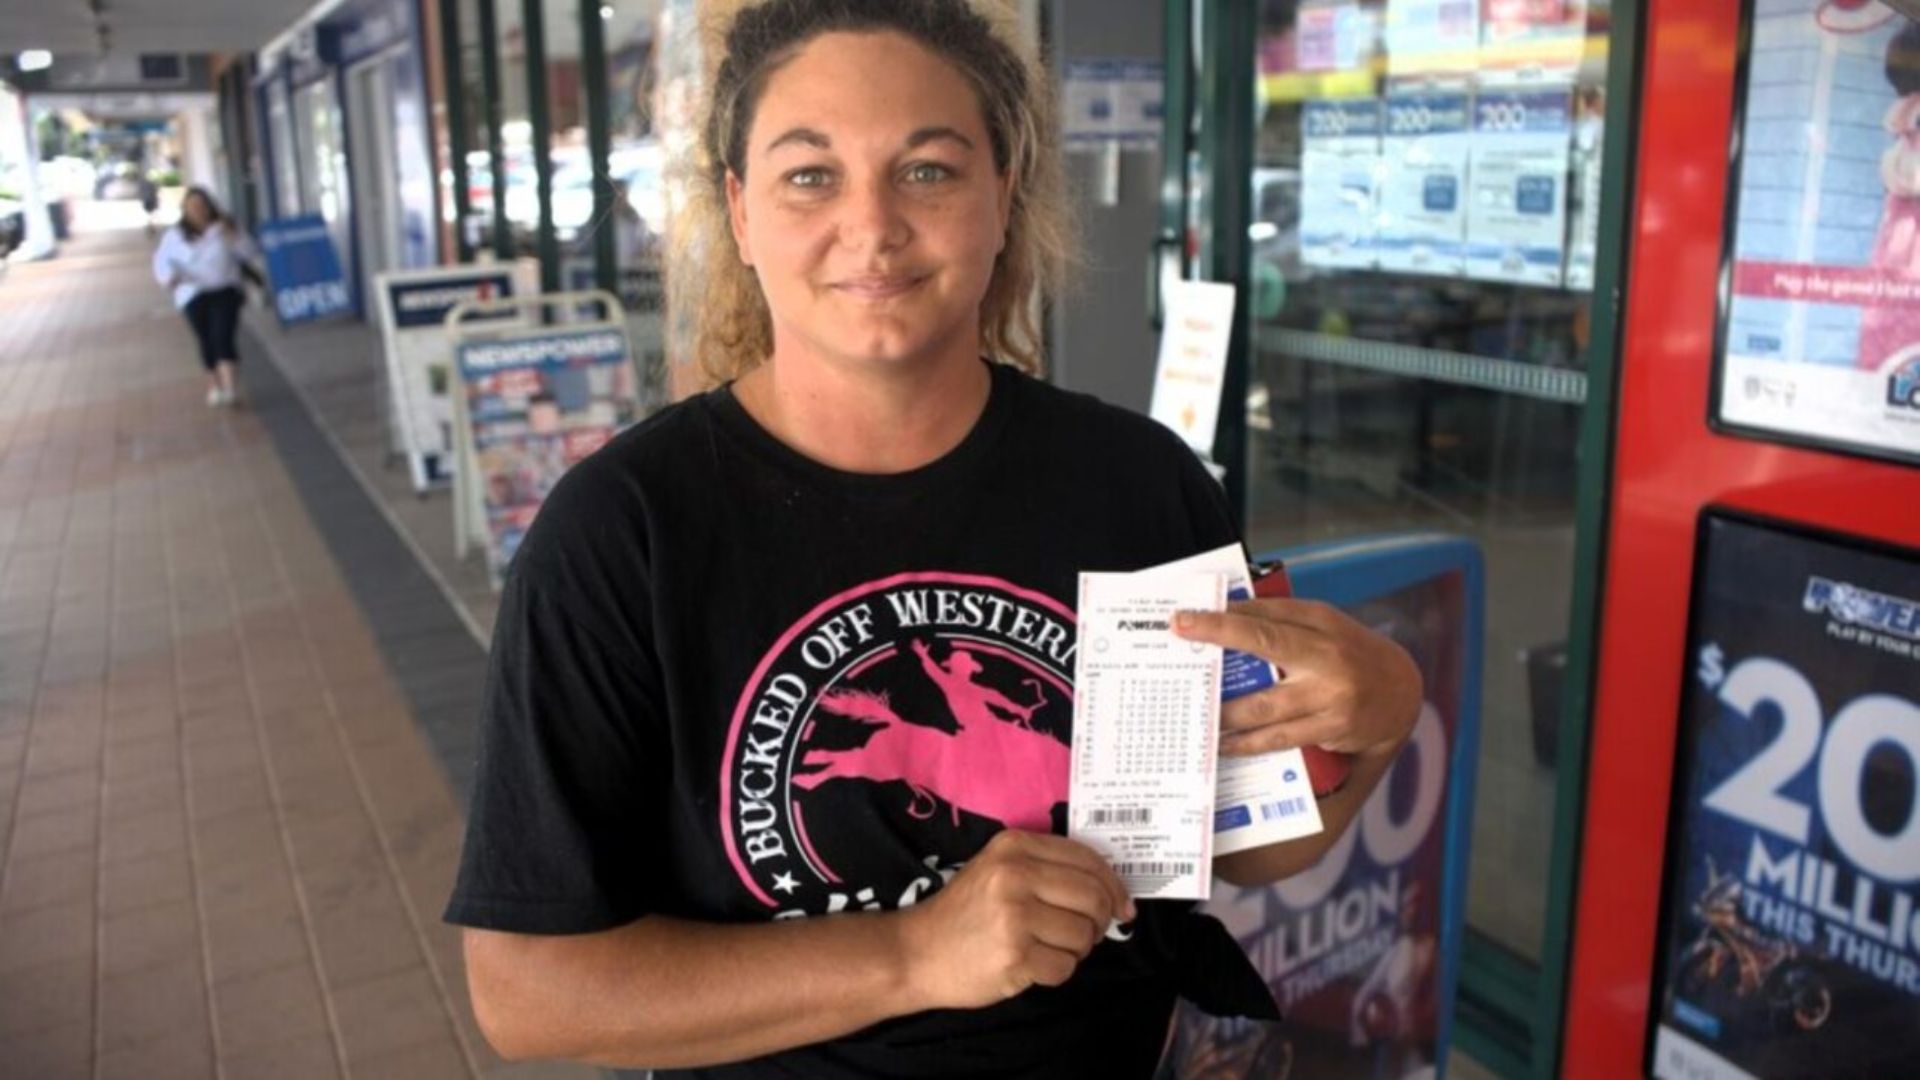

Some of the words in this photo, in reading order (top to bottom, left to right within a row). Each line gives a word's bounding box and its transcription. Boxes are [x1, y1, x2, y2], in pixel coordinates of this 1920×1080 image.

[1478, 104, 1526, 132] 200
[278, 282, 348, 320] OPEN
[463, 333, 622, 366] NEWSPOWER
[740, 673, 808, 864] BUCKED
[800, 604, 874, 670] OFF
[885, 589, 1080, 668] WESTER
[1743, 887, 1815, 944] THIS
[1746, 832, 1920, 955] MILLI
